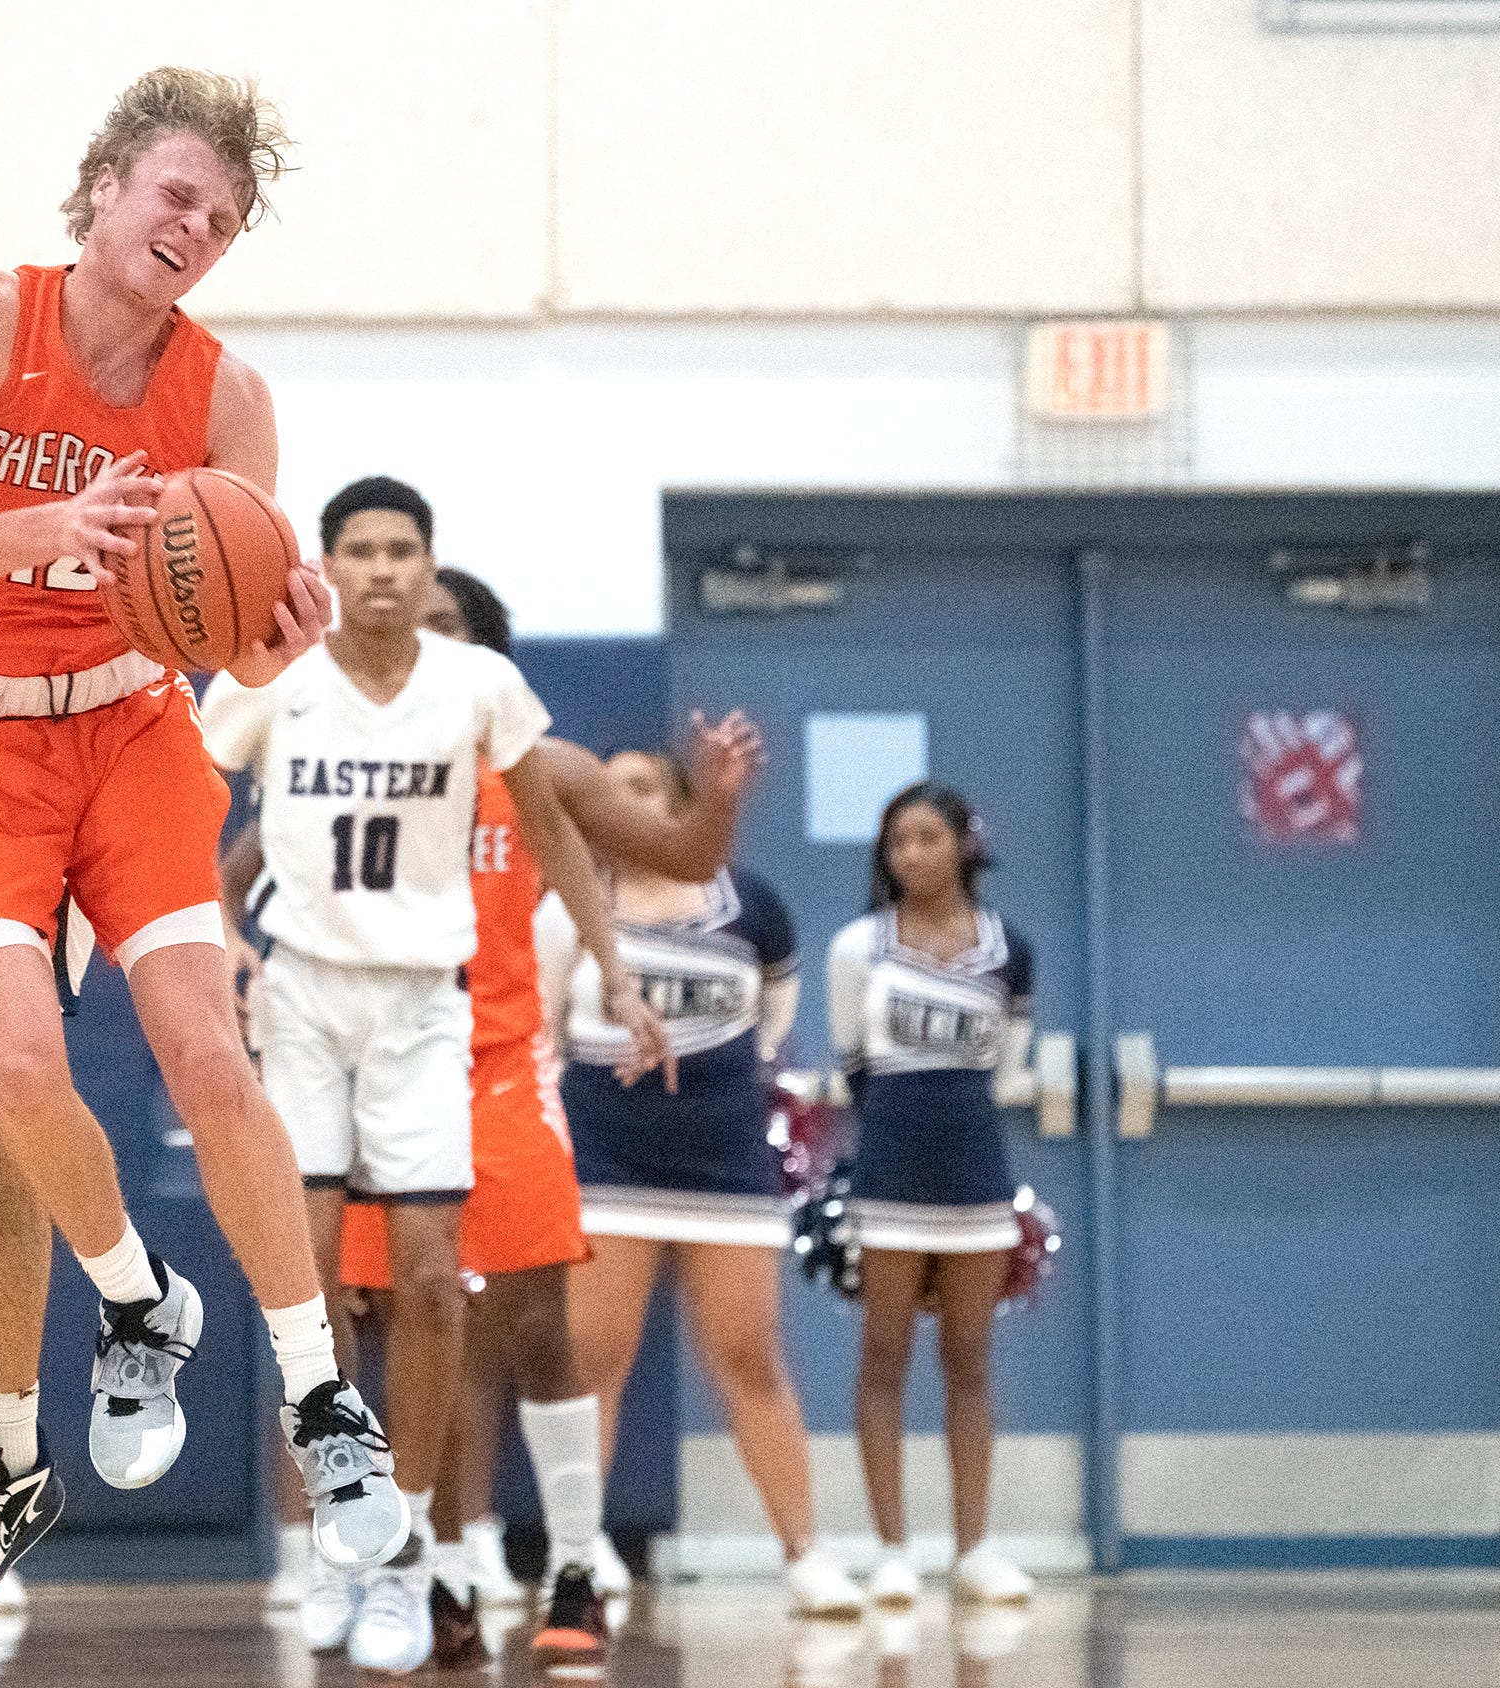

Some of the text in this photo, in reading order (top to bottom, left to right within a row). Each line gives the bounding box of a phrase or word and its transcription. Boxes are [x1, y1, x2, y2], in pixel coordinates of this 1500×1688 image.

[1055, 328, 1150, 411] EXIT
[162, 511, 209, 646] Wilson
[287, 757, 452, 800] EASTERN
[331, 813, 400, 892] 10
